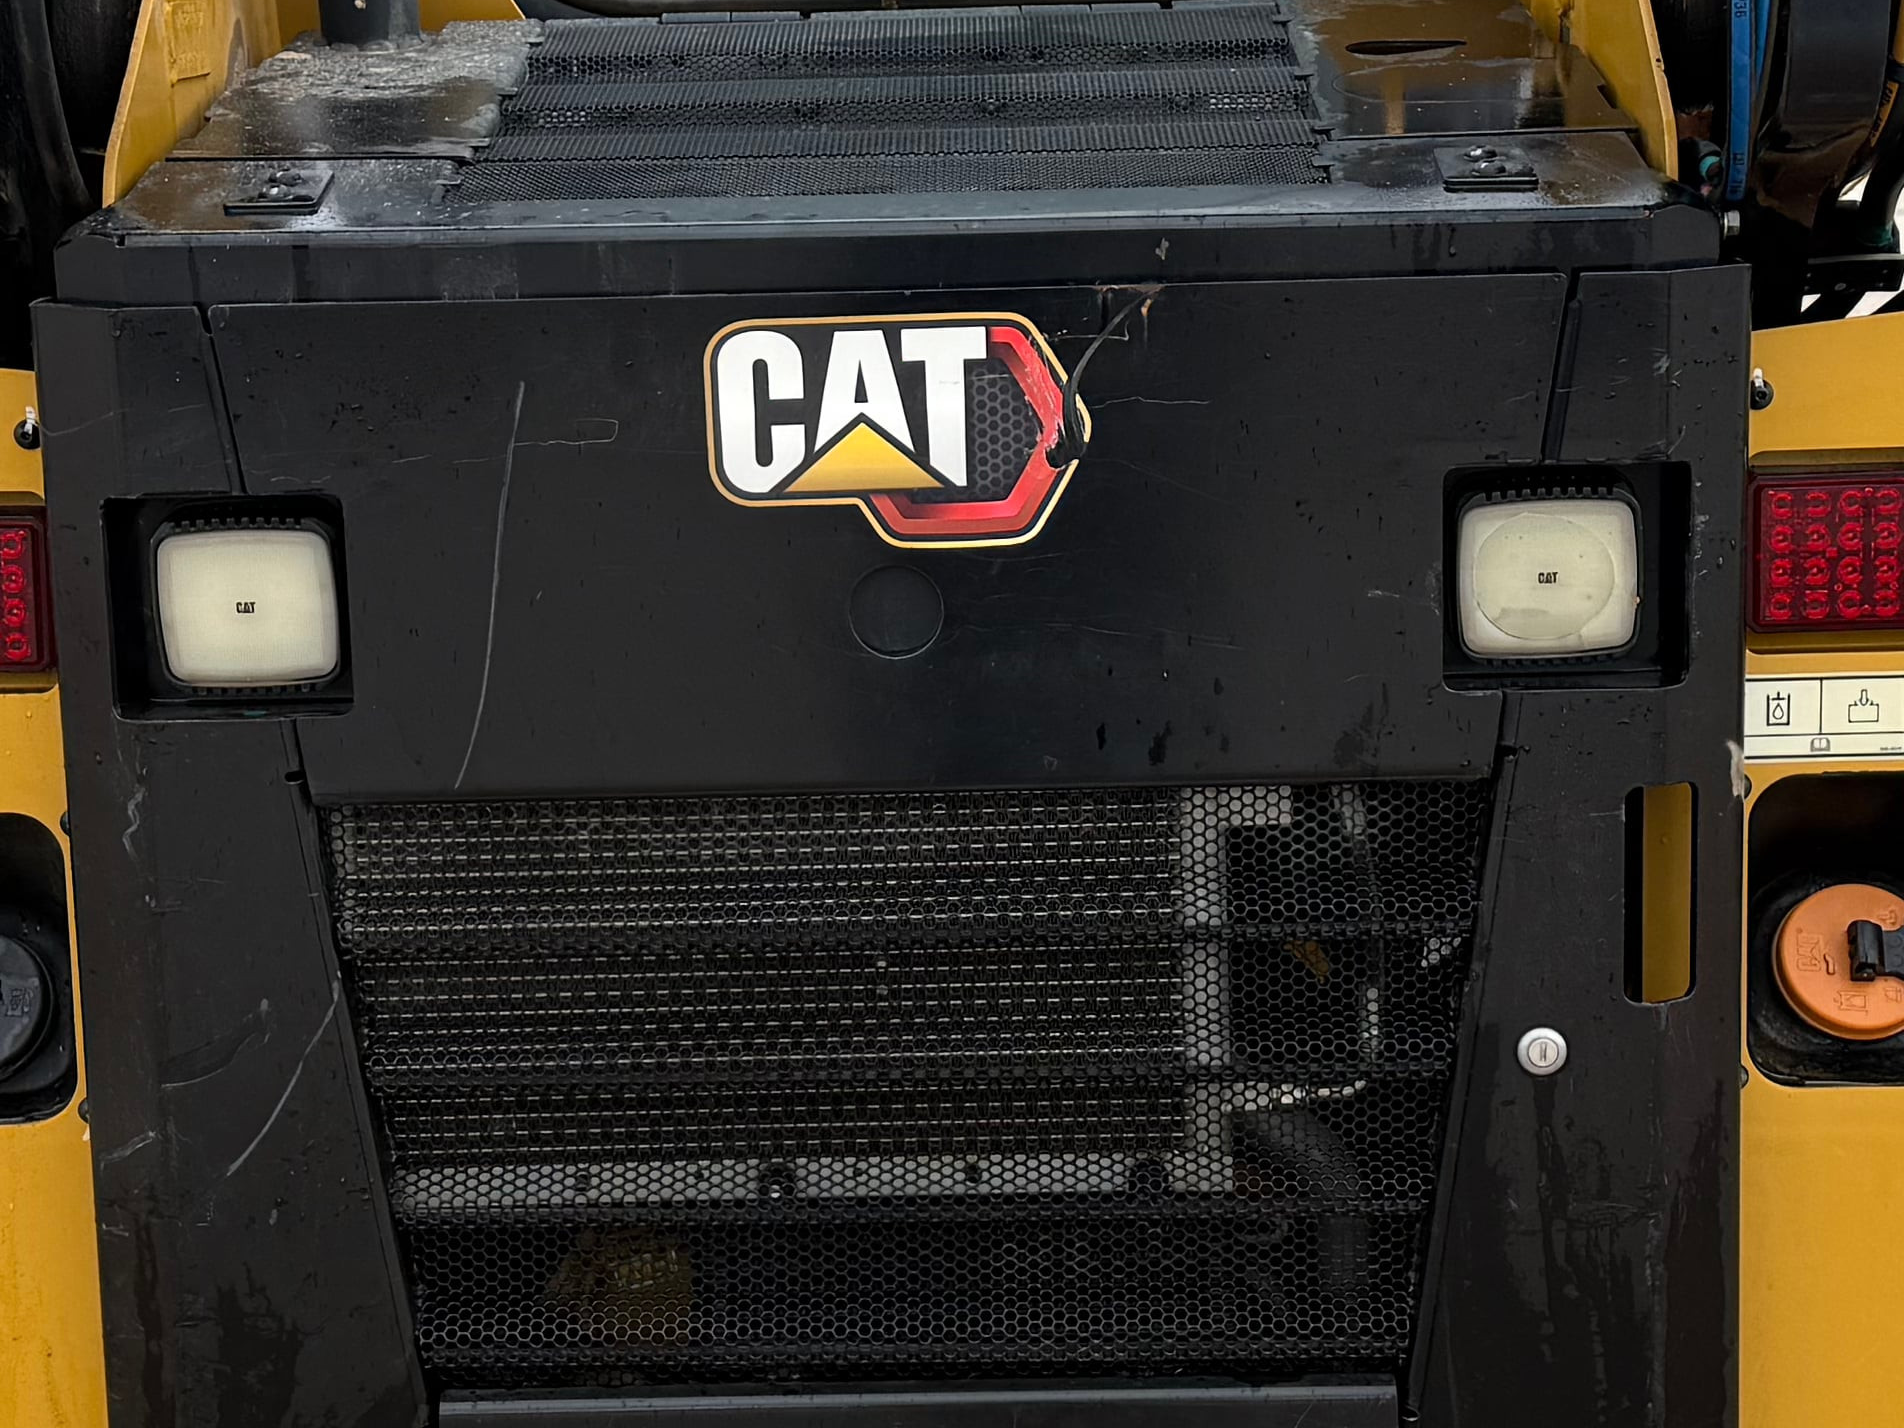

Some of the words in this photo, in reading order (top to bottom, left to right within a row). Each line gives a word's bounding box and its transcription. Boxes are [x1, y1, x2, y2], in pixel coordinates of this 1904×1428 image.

[717, 326, 987, 493] CAT
[1537, 571, 1559, 584] CAT
[235, 601, 256, 614] CAT
